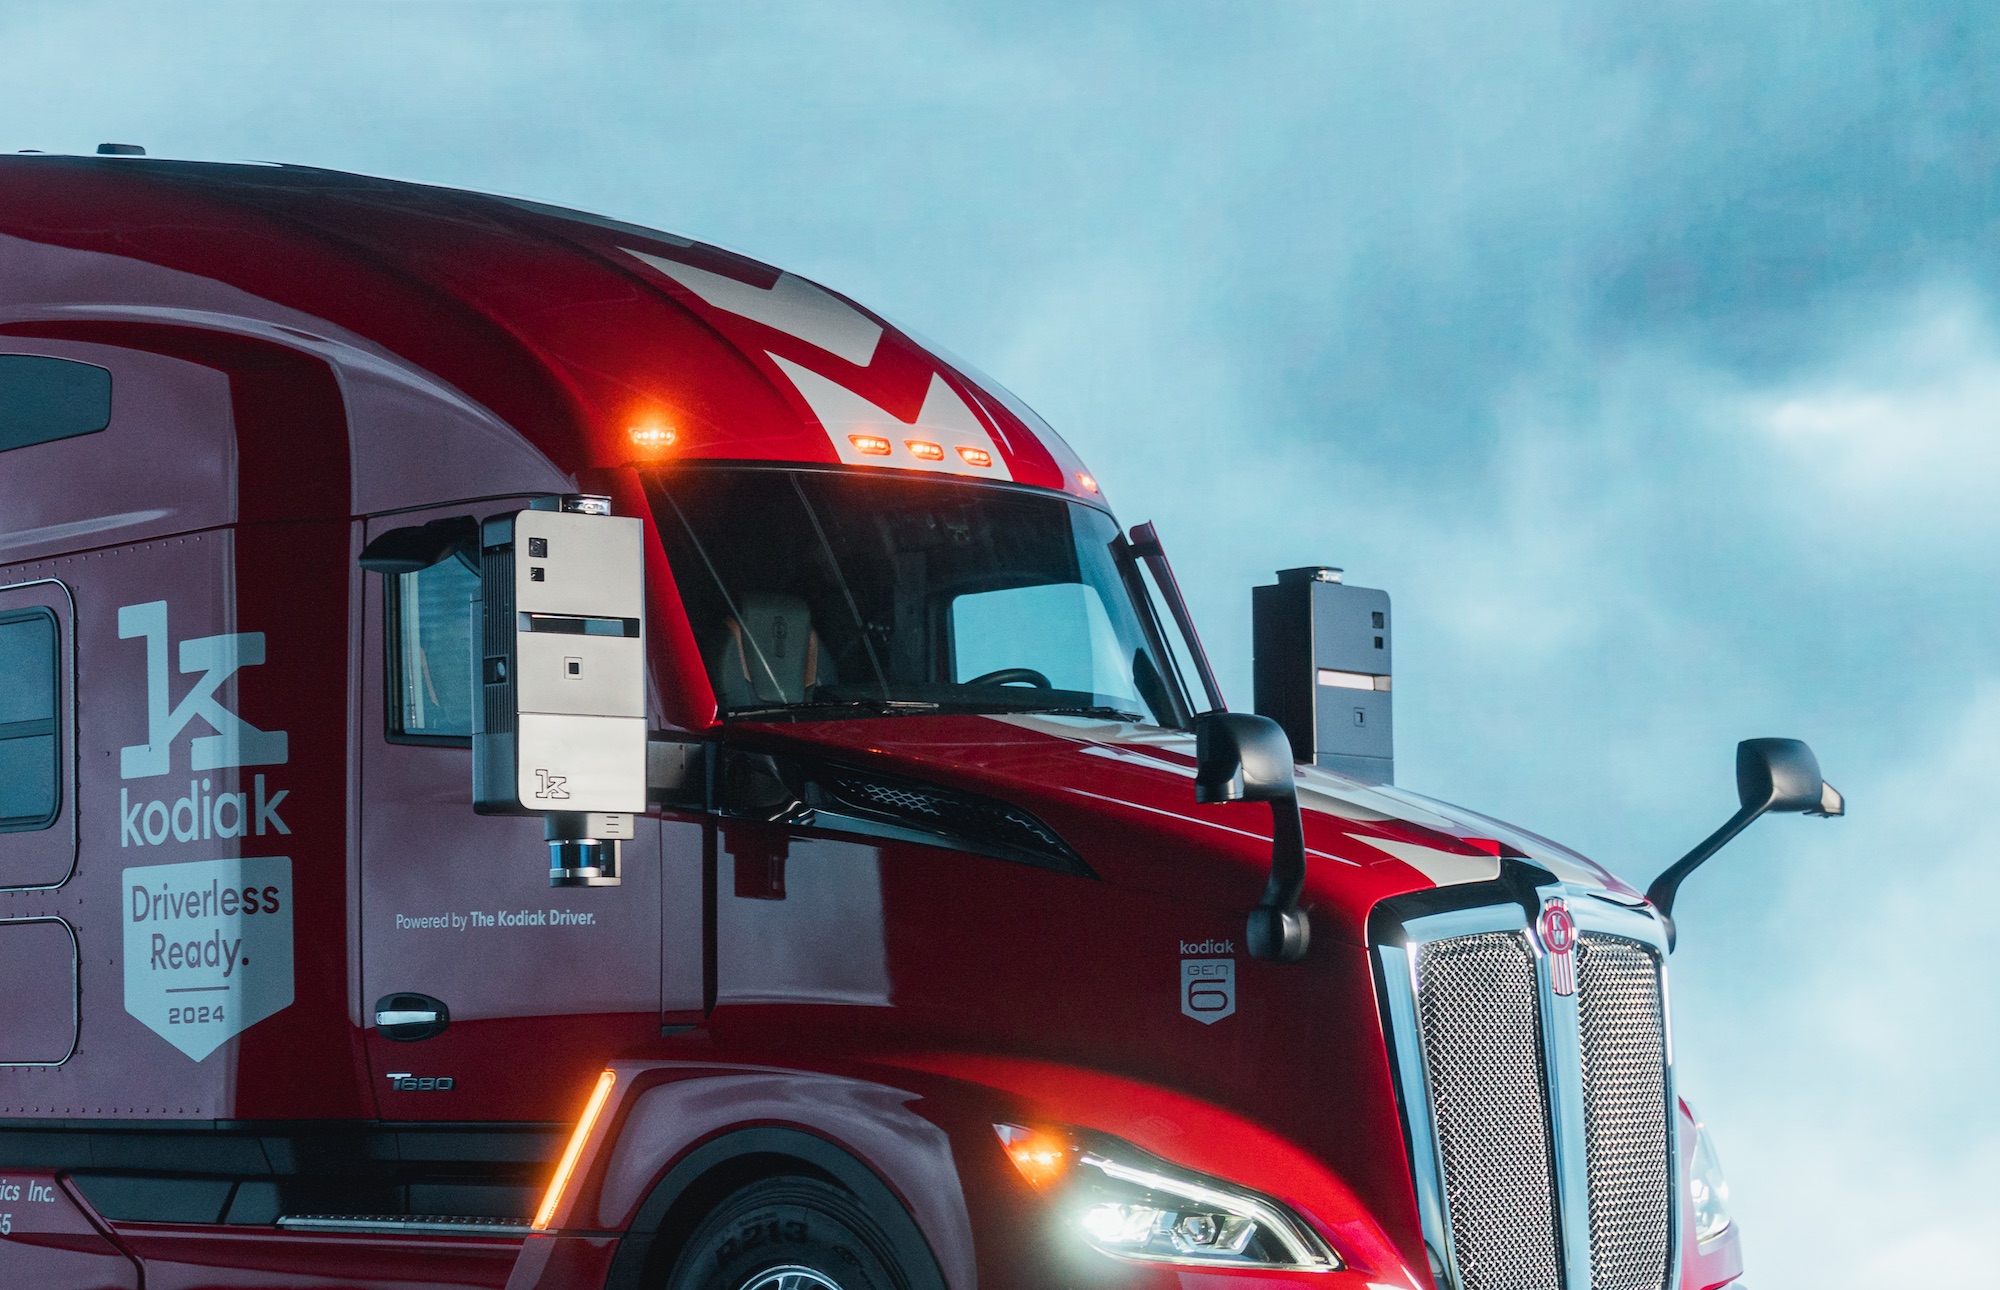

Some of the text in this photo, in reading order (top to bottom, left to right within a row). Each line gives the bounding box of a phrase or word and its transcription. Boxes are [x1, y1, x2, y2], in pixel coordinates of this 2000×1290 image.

[118, 600, 289, 780] k
[120, 774, 292, 848] kodiak
[132, 878, 280, 923] Driverless
[396, 908, 596, 932] Powered by The Kodiak Driver.
[152, 928, 249, 978] Ready.
[1180, 939, 1235, 955] kodiak
[1188, 979, 1228, 1012] 6
[168, 1005, 225, 1025] 2024
[386, 1073, 454, 1091] T680
[0, 1179, 55, 1203] ics Inc.
